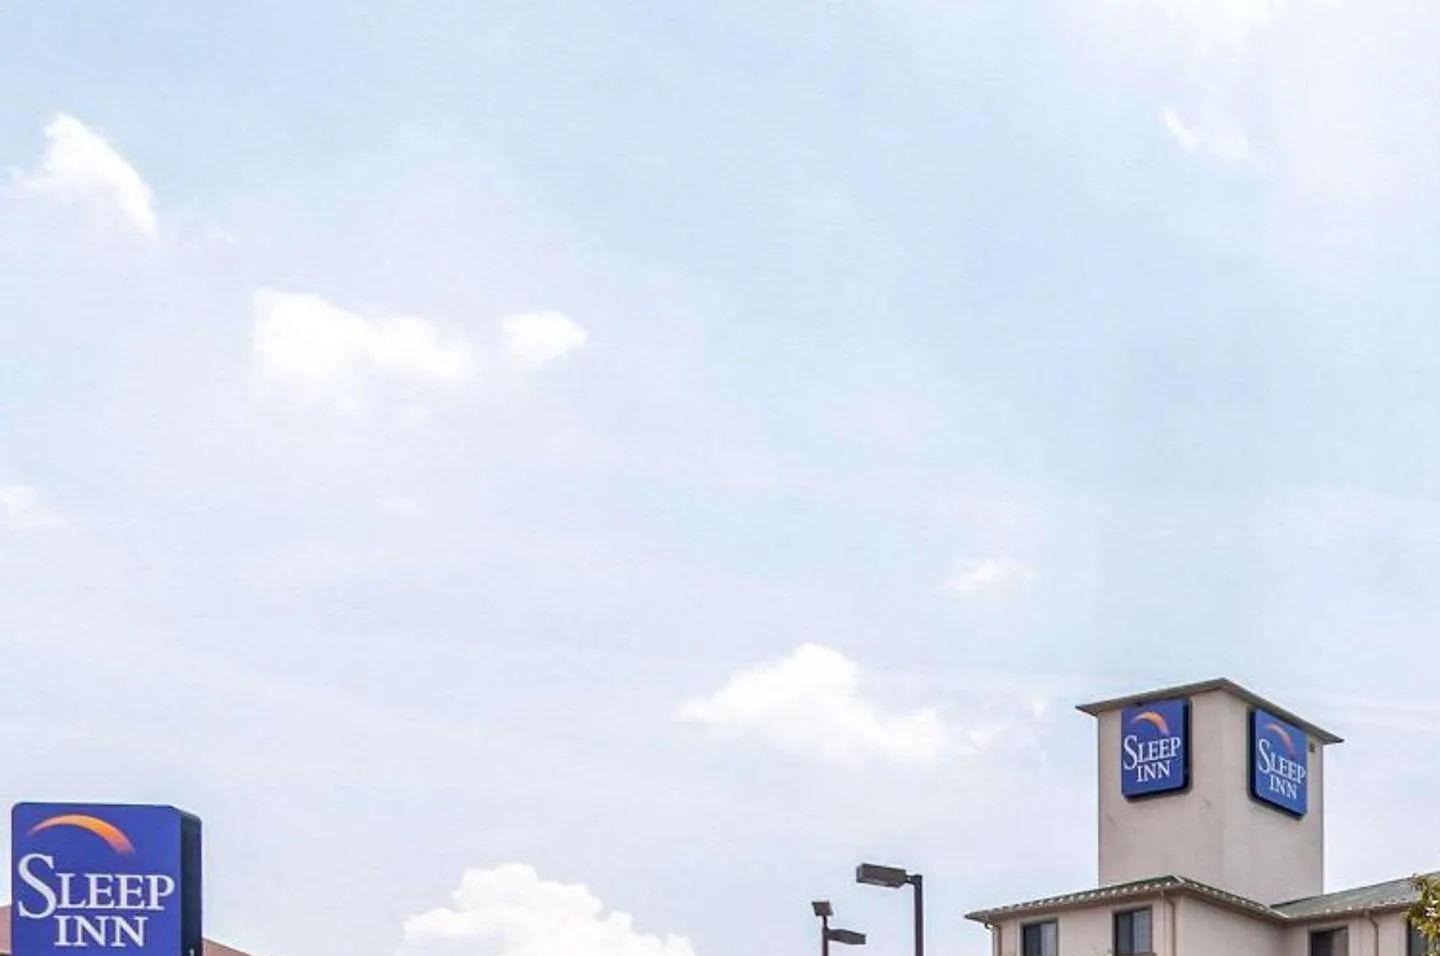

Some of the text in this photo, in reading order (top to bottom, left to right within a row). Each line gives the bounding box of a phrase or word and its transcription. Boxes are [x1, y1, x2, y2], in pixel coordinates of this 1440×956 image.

[1123, 735, 1181, 770] SLEEP
[1258, 738, 1305, 784] SLEEP
[1137, 760, 1170, 783] INN
[1269, 775, 1298, 799] INN
[18, 853, 175, 918] SLEEP
[54, 914, 148, 947] INN
